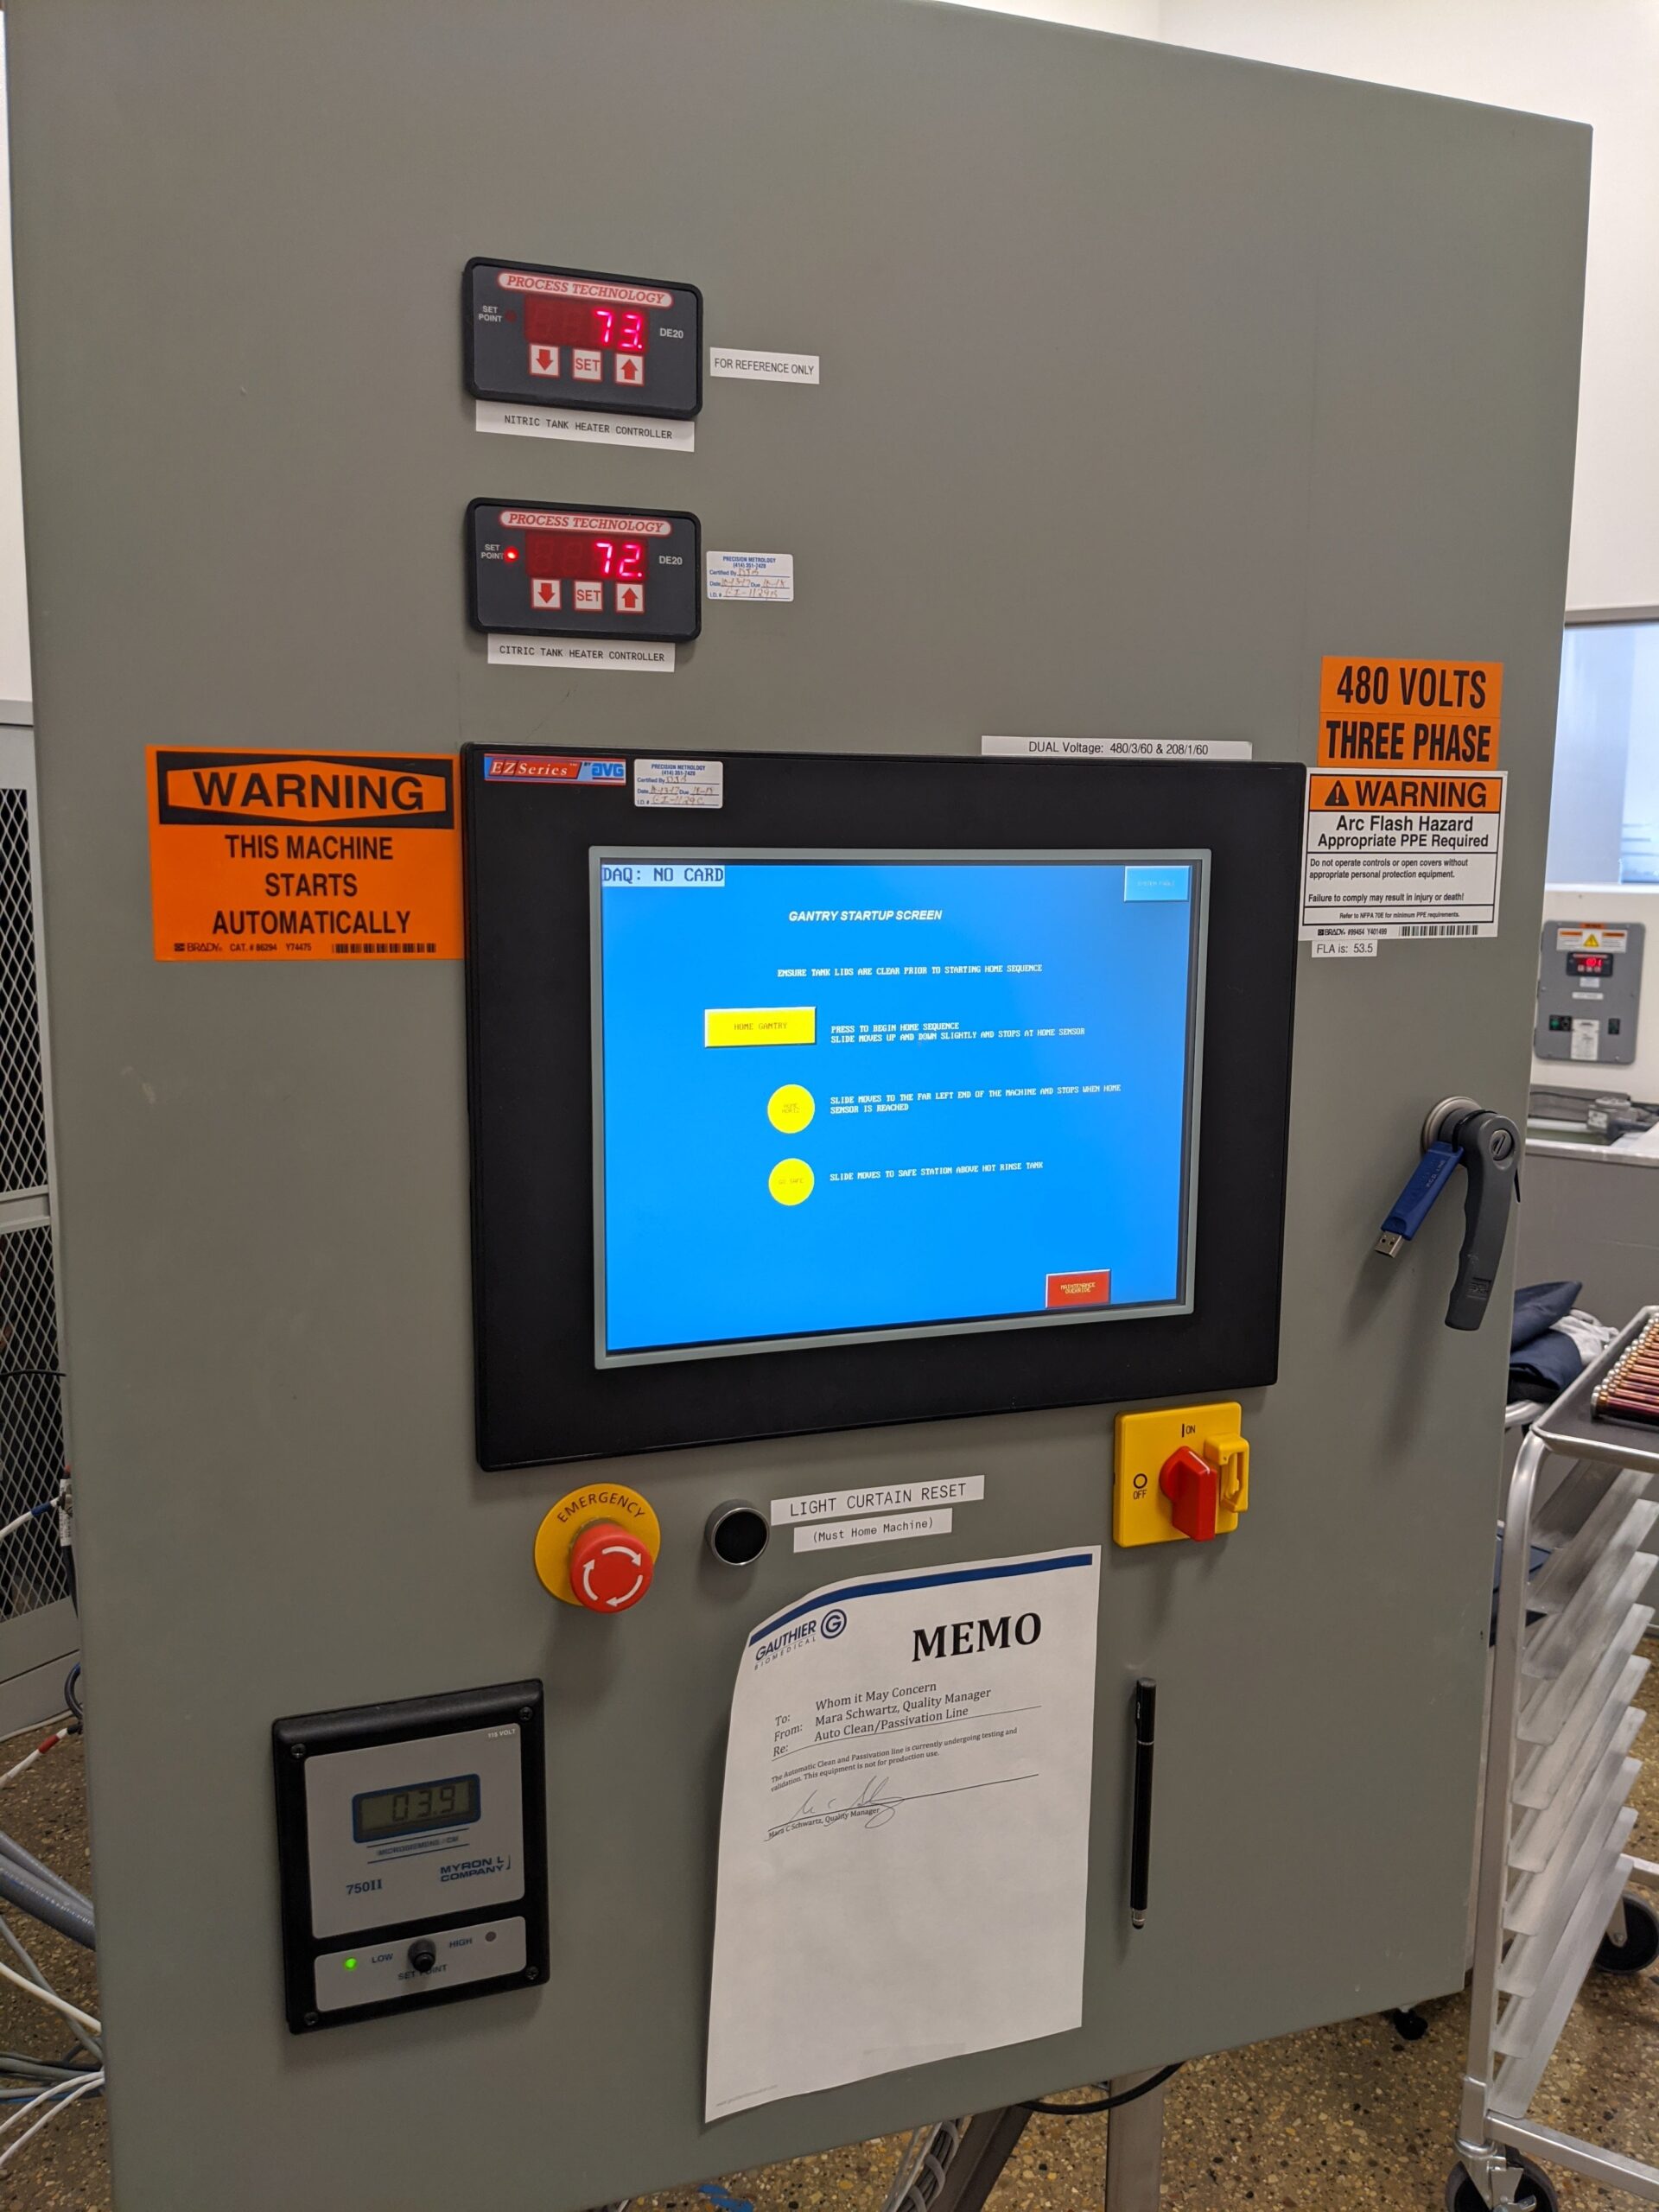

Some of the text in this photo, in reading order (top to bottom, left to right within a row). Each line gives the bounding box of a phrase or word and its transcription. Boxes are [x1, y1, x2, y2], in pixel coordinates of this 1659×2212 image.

[506, 275, 665, 305] PROCESS TECHNOLOGY
[478, 313, 502, 323] POINT
[482, 305, 498, 315] SET
[659, 327, 684, 340] DE20
[575, 358, 600, 372] SET
[714, 357, 814, 374] FOR REFERENCE ONLY
[504, 414, 672, 439] NITRIC TANK HEATER CONTROLLER
[509, 513, 664, 533] PROCESS TECHNOLOGY
[480, 551, 504, 560] POINT
[659, 556, 683, 567] DE20
[576, 589, 601, 602] SET
[499, 645, 664, 661] CITRIC TANK HEATER CONTROLLER
[1337, 665, 1486, 709] 480 VOLTS
[1028, 741, 1208, 754] DUAL Voltage: 480/3/60 & 208/1/60
[1325, 720, 1491, 762] THREE PHASE
[194, 772, 423, 810] WARNING
[1356, 780, 1486, 807] WARNING
[1336, 815, 1472, 831] Arc Flash Hazard
[225, 834, 392, 859] THIS MACHINE
[1317, 833, 1488, 849] Appropriate PPE Required
[1335, 859, 1361, 868] operate
[1402, 860, 1417, 868] open
[604, 867, 724, 883] DAQ: NO CARD
[1310, 871, 1455, 880] appropriate personal protection equipment.
[265, 872, 357, 897] STARTS
[1308, 893, 1332, 902] Failure
[1343, 893, 1367, 903] comply
[1414, 893, 1433, 902] injury
[213, 910, 410, 934] AUTOMATICALLY
[788, 909, 942, 921] GANTRY STARTUP SCREEN
[1317, 944, 1373, 954] FLA is: 53.5
[810, 968, 830, 976] TANK
[1006, 963, 1042, 973] SEQUENCE
[831, 1025, 855, 1033] PRESS
[923, 1022, 958, 1031] SEQUENCE
[830, 1172, 853, 1180] SLIDE
[898, 1168, 916, 1177] SAFE
[920, 1166, 952, 1175] STATION
[956, 1165, 978, 1173] ABOVE
[790, 1482, 966, 1516] LIGHT CURTAIN RESET
[1134, 1490, 1147, 1499] OFF
[557, 1491, 645, 1522] EMERGENCY
[813, 1517, 932, 1542] (Must Home Machine)
[755, 1619, 817, 1661] GAUTHIER
[912, 1612, 1042, 1662] MEMO
[754, 1637, 816, 1671] BIOMEDICAL
[775, 1683, 936, 1726] To: Whom it May Concern
[774, 1689, 991, 1743] From: Mara Schwartz, Quality Manager
[772, 1706, 969, 1758] Re: Auto Clean/Passivation Line
[784, 1764, 816, 1778] Automatic
[817, 1759, 836, 1768] Clean
[852, 1749, 890, 1761] Passivation
[912, 1740, 942, 1751] currently
[944, 1734, 980, 1745] undergoing
[982, 1730, 1004, 1738] testing
[1006, 1727, 1018, 1736] and
[441, 1858, 493, 1874] MYRON
[441, 1865, 505, 1882] COMPANY
[449, 1937, 473, 1948] HIGH
[372, 1953, 393, 1963] LOW
